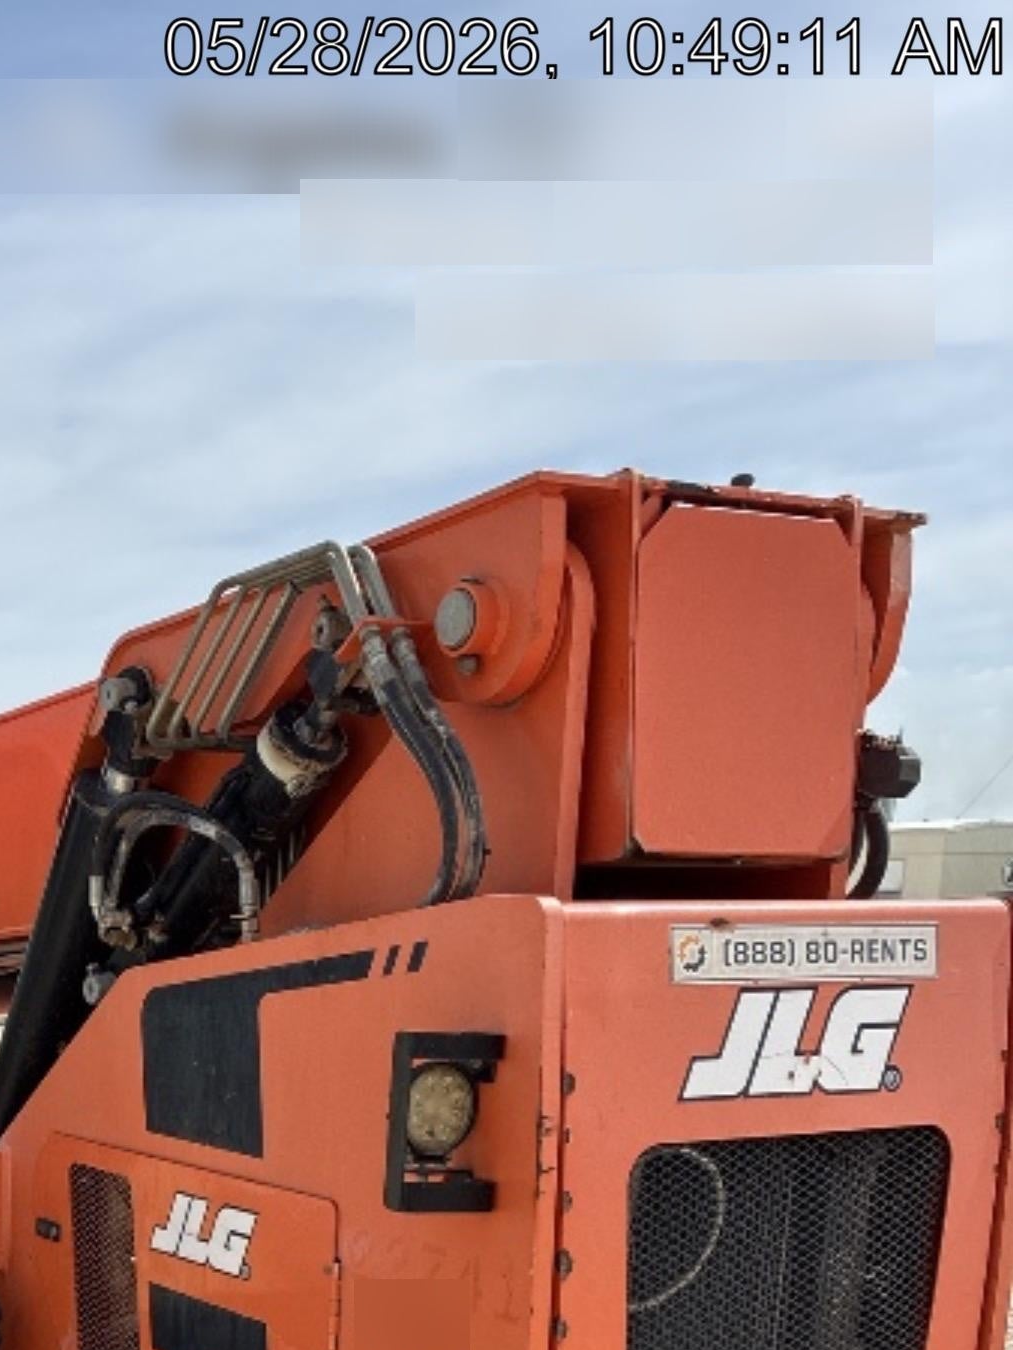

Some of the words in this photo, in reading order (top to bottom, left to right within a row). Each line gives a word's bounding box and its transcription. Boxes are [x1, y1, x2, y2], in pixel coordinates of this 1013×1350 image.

[723, 938, 796, 967] (888)
[805, 937, 928, 965] 80-RENTS
[678, 985, 913, 1101] JLG
[149, 1190, 259, 1279] JLG
